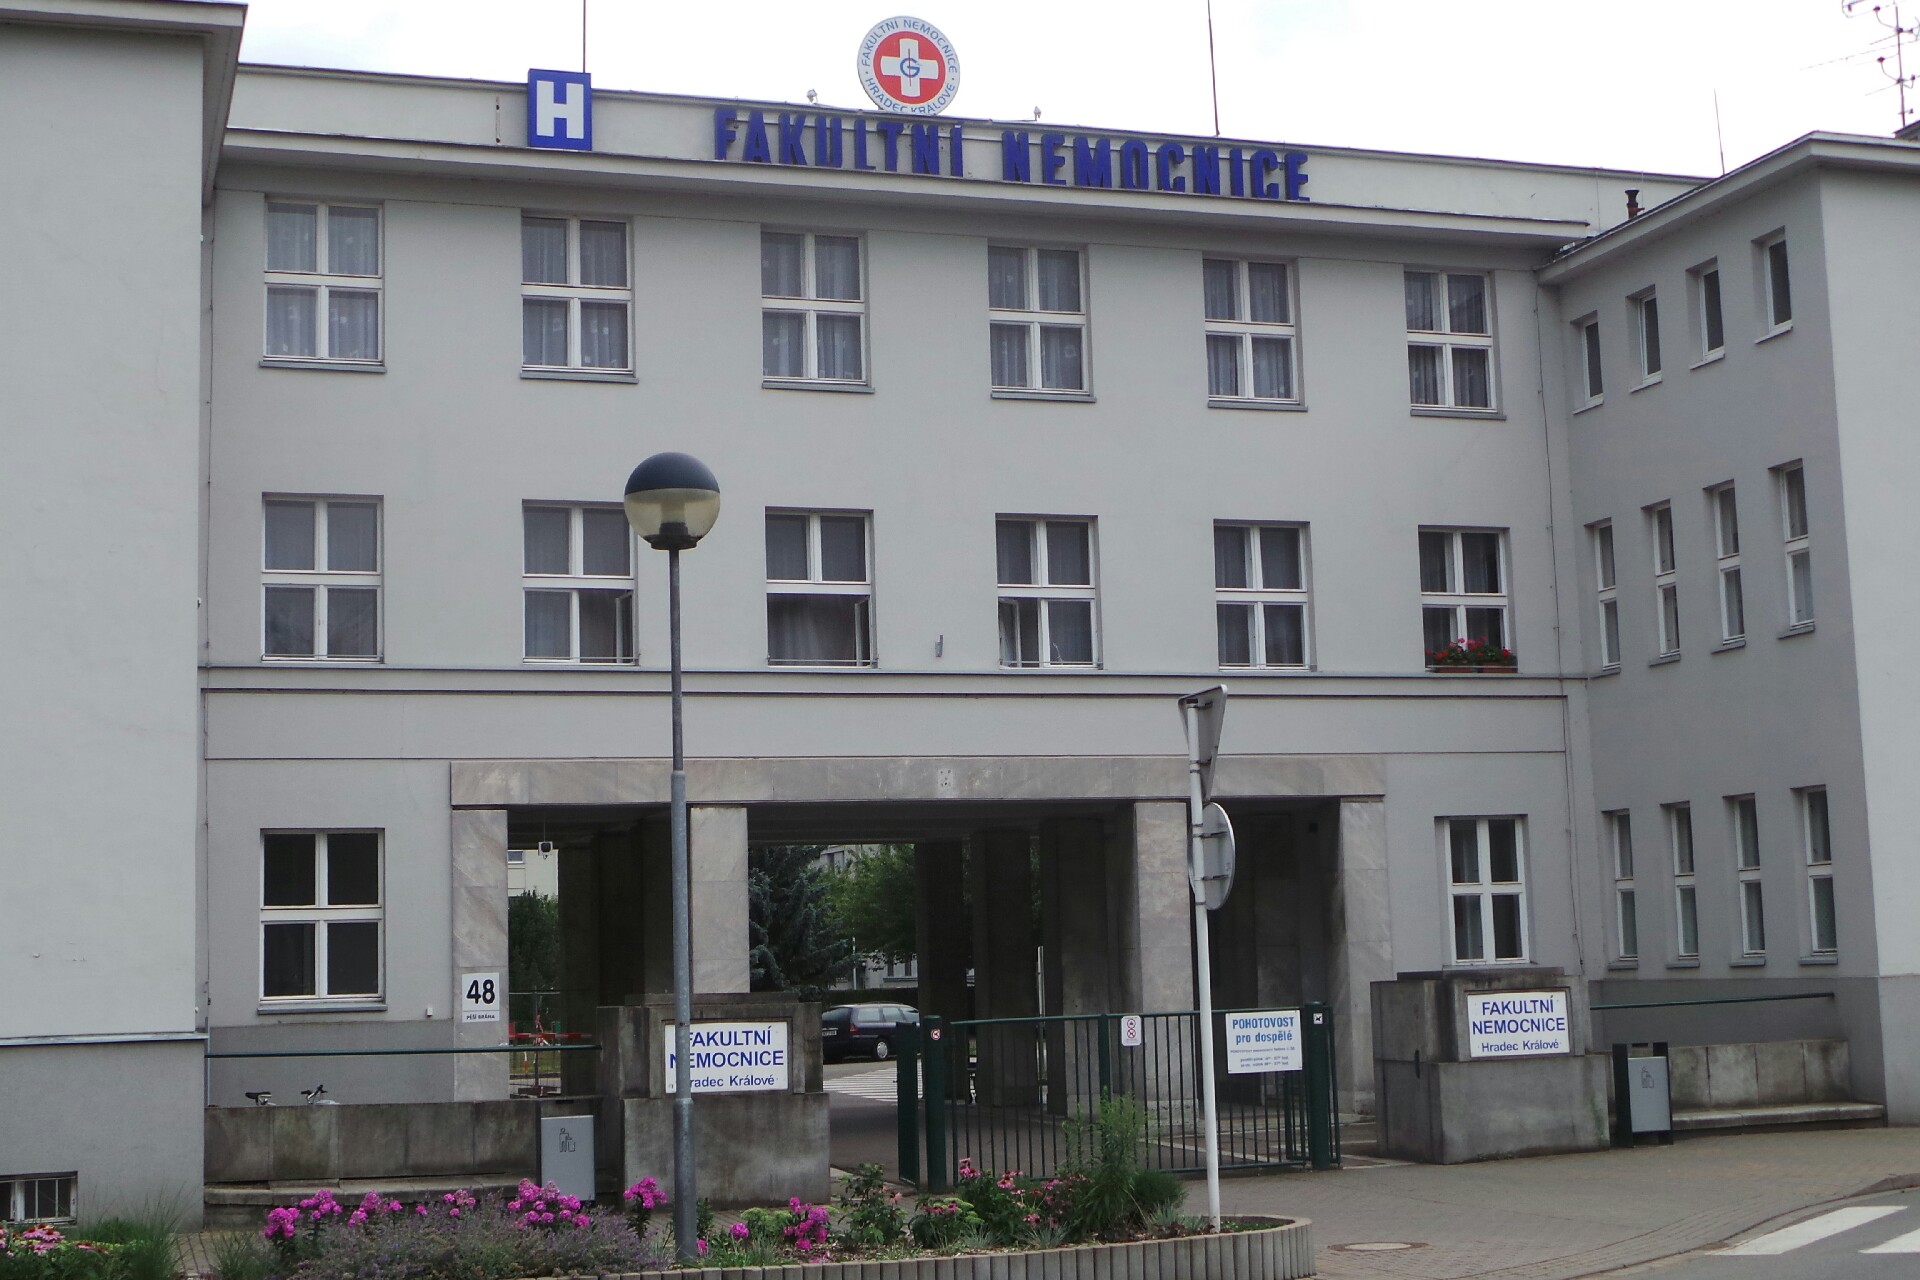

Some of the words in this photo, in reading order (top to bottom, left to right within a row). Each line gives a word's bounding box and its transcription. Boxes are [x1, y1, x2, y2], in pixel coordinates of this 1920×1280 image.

[903, 20, 958, 73] NEMOCNICE
[536, 80, 584, 139] H
[1002, 130, 1310, 202] NEMOCNICE
[466, 979, 496, 1005] 48
[1482, 995, 1554, 1015] FAKULTNÍ
[1232, 1017, 1295, 1029] POHOTOVOST
[1472, 1017, 1566, 1035] NEMOCNICE
[1236, 1034, 1251, 1045] pro
[1255, 1030, 1293, 1044] dospělé
[1481, 1041, 1519, 1052] Hradec
[1523, 1038, 1559, 1051] Králové
[690, 1076, 724, 1088] radec
[729, 1074, 775, 1087] Králové
